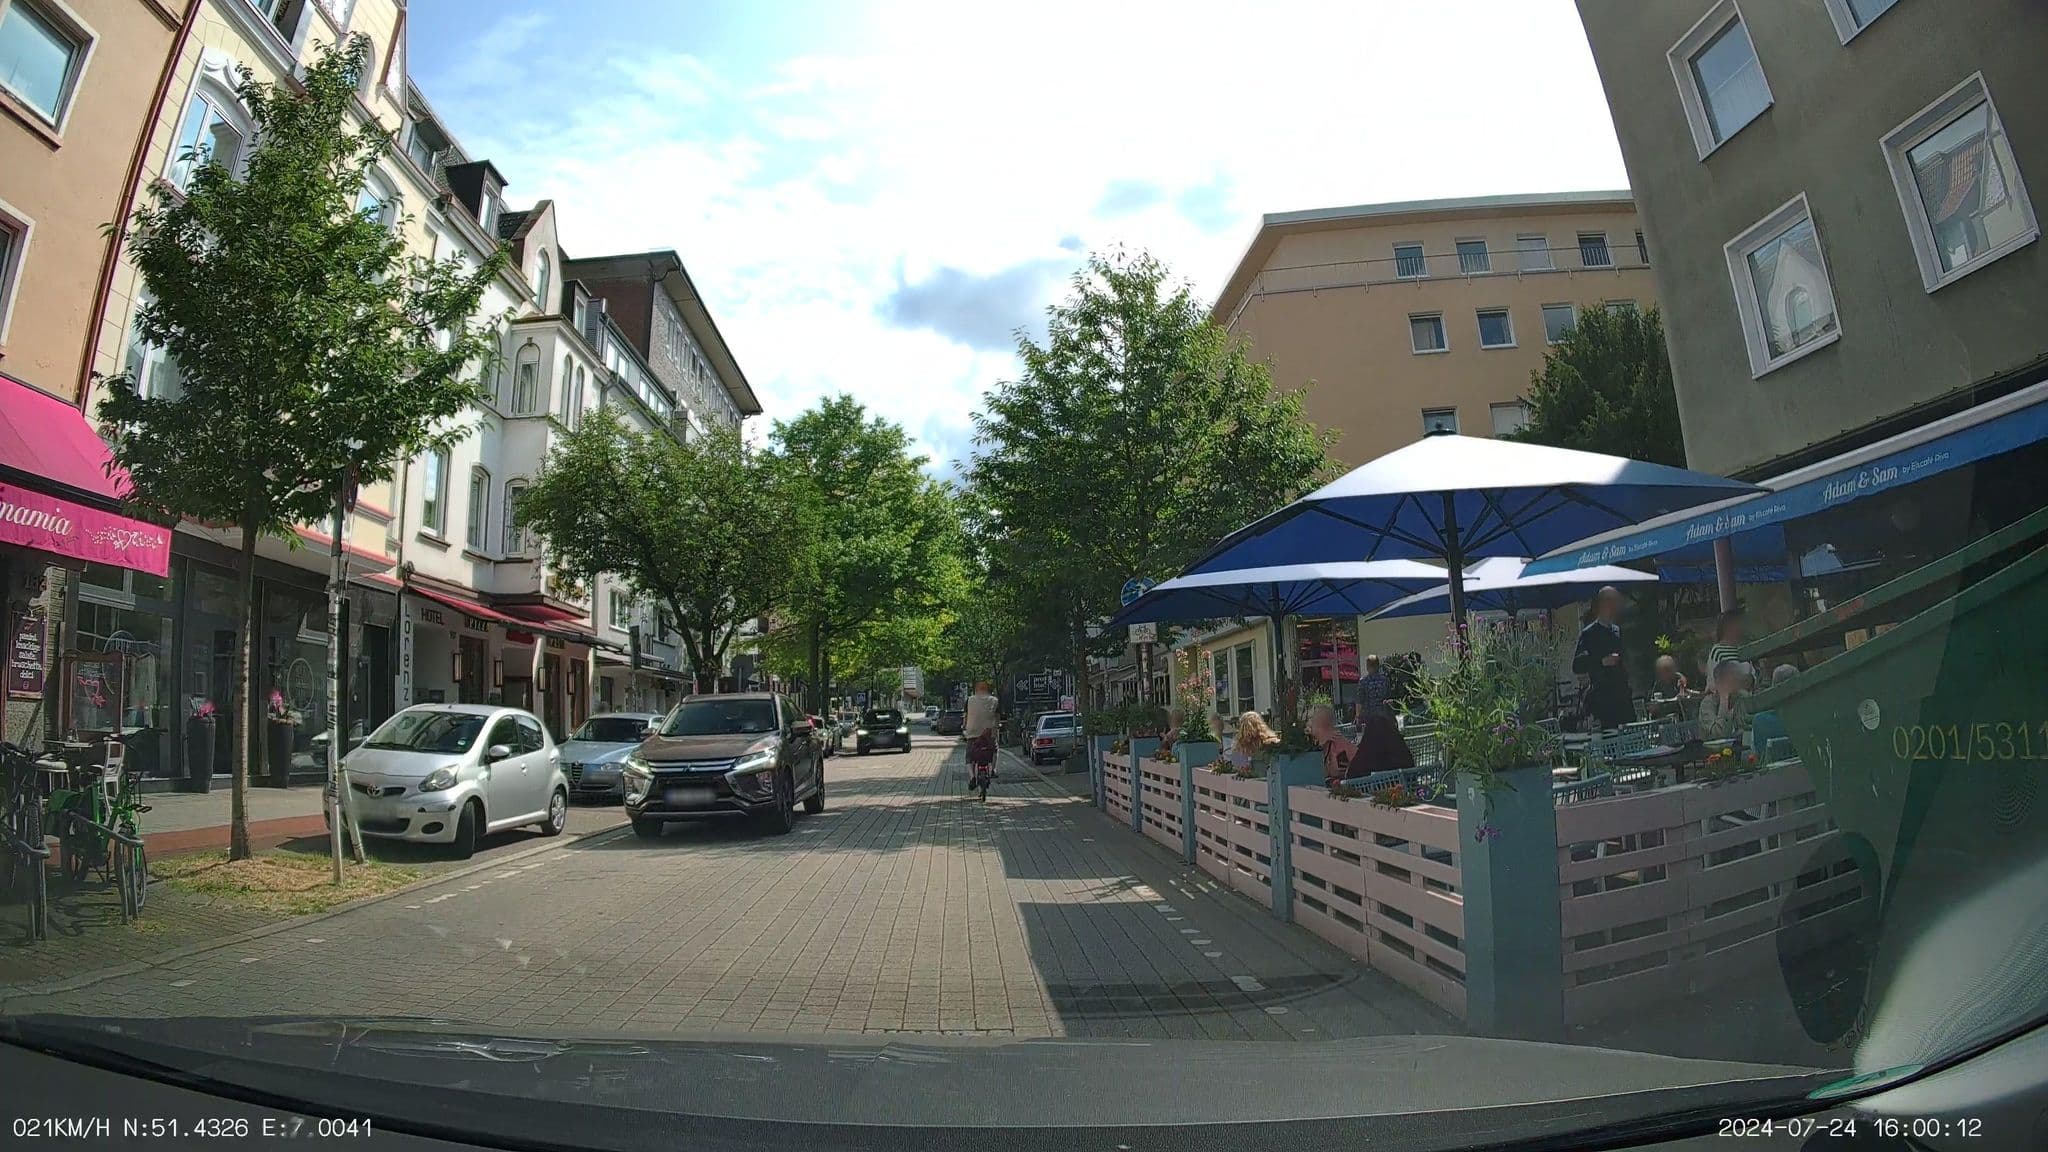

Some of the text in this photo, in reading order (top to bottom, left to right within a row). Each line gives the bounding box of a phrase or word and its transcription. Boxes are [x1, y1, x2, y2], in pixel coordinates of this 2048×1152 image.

[1823, 480, 1856, 503] Adam
[1858, 471, 1869, 488] &
[1872, 466, 1898, 486] Sam
[1687, 521, 1713, 541] Adam
[1715, 515, 1723, 531] &
[1724, 513, 1746, 530] Sam
[1578, 551, 1600, 566] Adam
[1601, 547, 1609, 560] &
[1609, 544, 1626, 559] Sam
[421, 607, 444, 626] HOTEL
[403, 602, 411, 702] Lorenz
